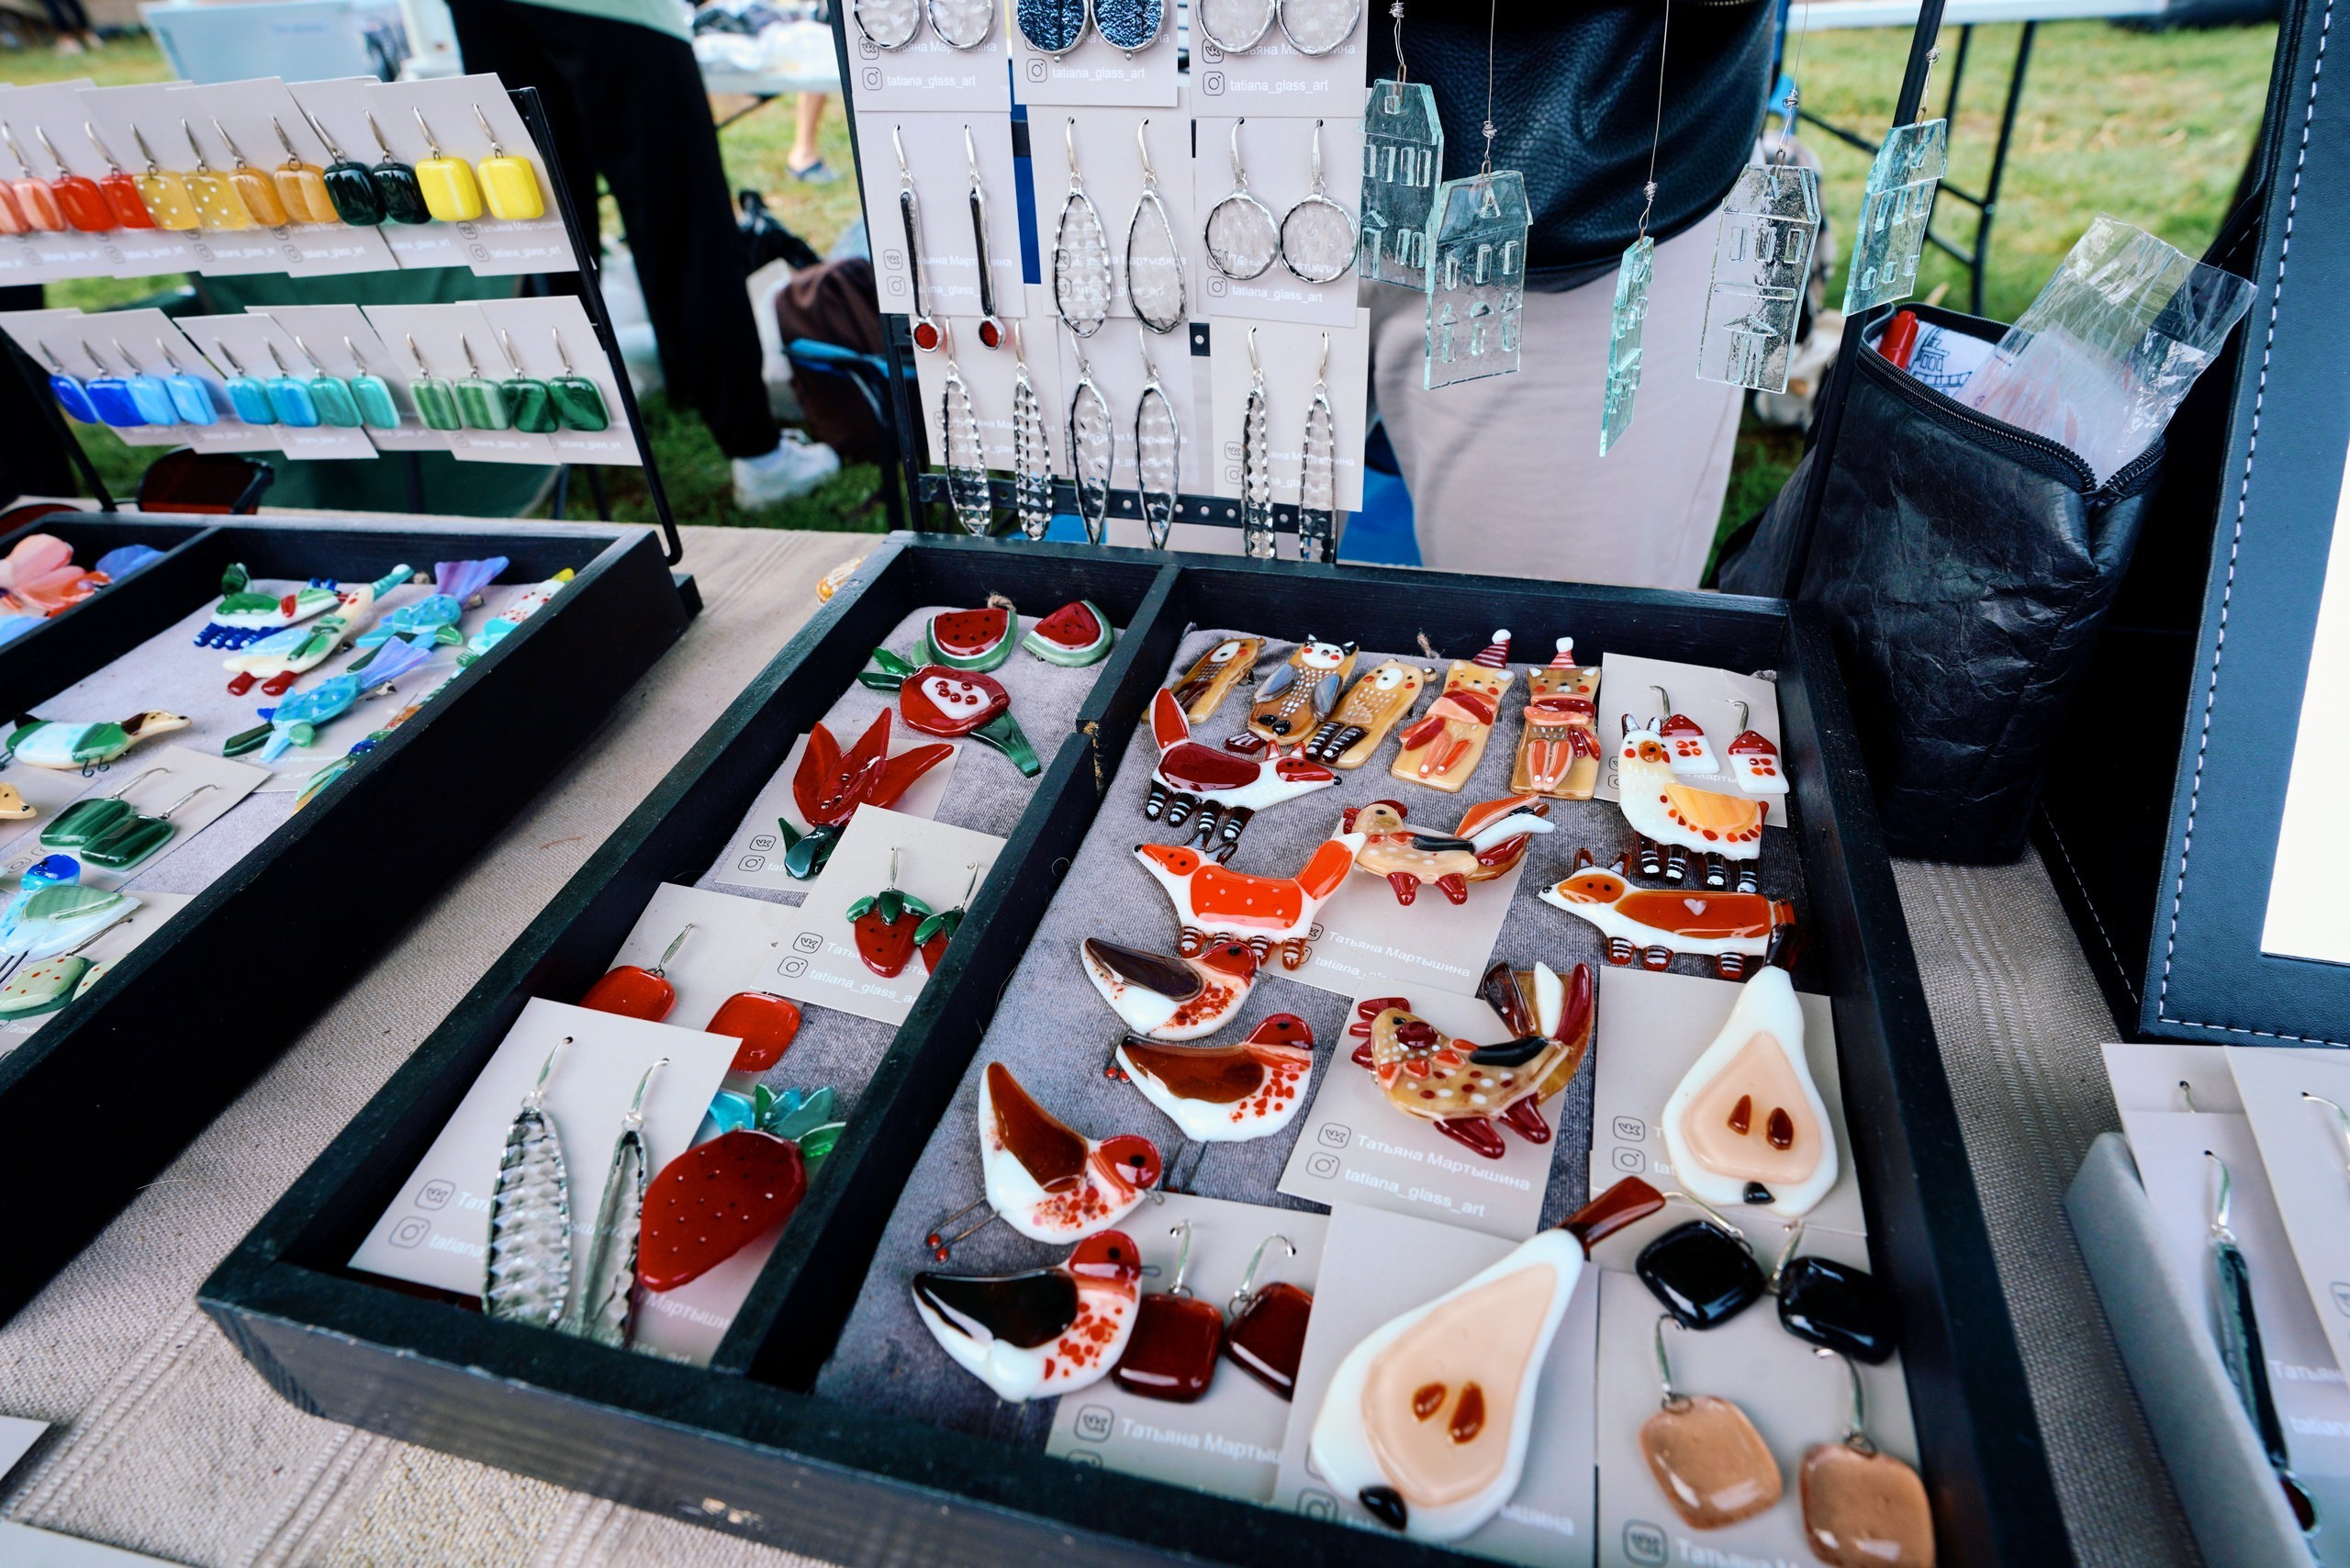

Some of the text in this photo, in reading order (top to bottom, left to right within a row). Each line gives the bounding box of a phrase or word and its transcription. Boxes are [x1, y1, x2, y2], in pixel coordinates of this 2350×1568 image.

[887, 75, 976, 89] tatiana_glass_art
[1052, 67, 1146, 81] tatiana_glass_art
[1230, 79, 1329, 94] tatiana_glass_art
[1232, 286, 1323, 304] tatiana_glass_art
[1328, 931, 1382, 954] Татьяна
[1385, 946, 1471, 978] Мартышина
[810, 969, 918, 1004] tatiana_glass_ar
[1358, 1134, 1531, 1192] Татьяна Мартышина
[1345, 1168, 1485, 1217] tatiana_glass_art
[646, 1293, 733, 1331] Мартыши
[1122, 1417, 1201, 1450] Татьяна
